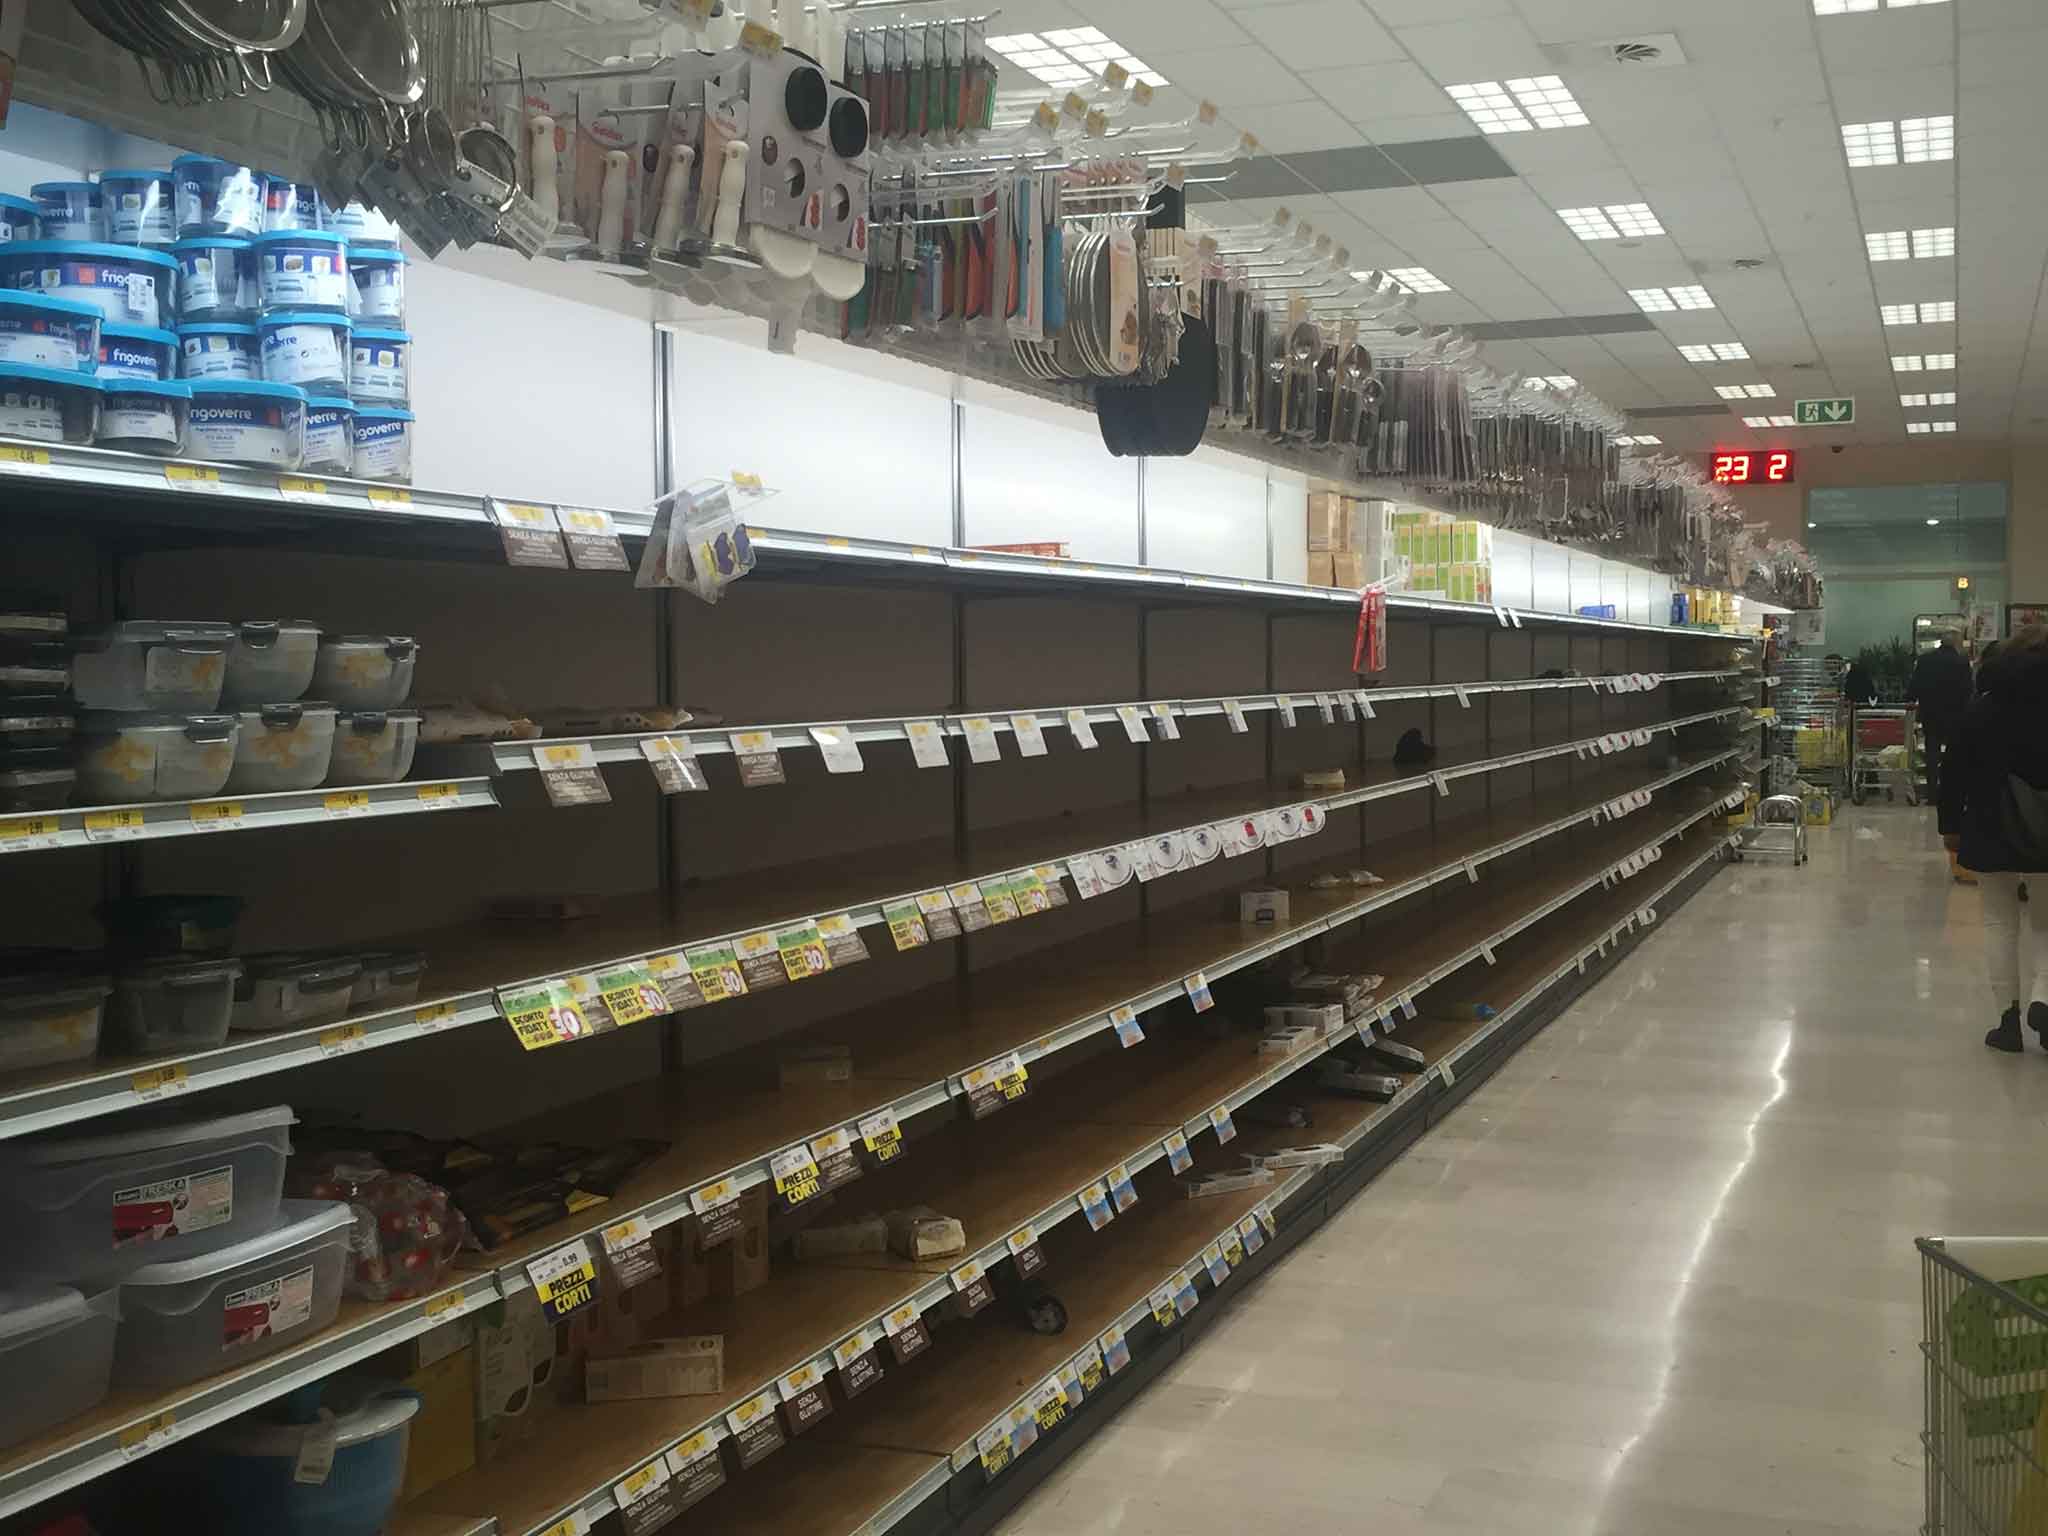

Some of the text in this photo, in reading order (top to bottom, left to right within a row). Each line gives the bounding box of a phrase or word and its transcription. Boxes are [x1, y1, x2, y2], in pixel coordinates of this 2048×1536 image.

[190, 407, 253, 421] rigoverre
[1715, 454, 1788, 481] 23 2
[782, 1166, 813, 1189] PREZZI
[787, 1178, 821, 1204] CORTI
[548, 1267, 587, 1296] PREZZI
[554, 1282, 593, 1314] CORTI
